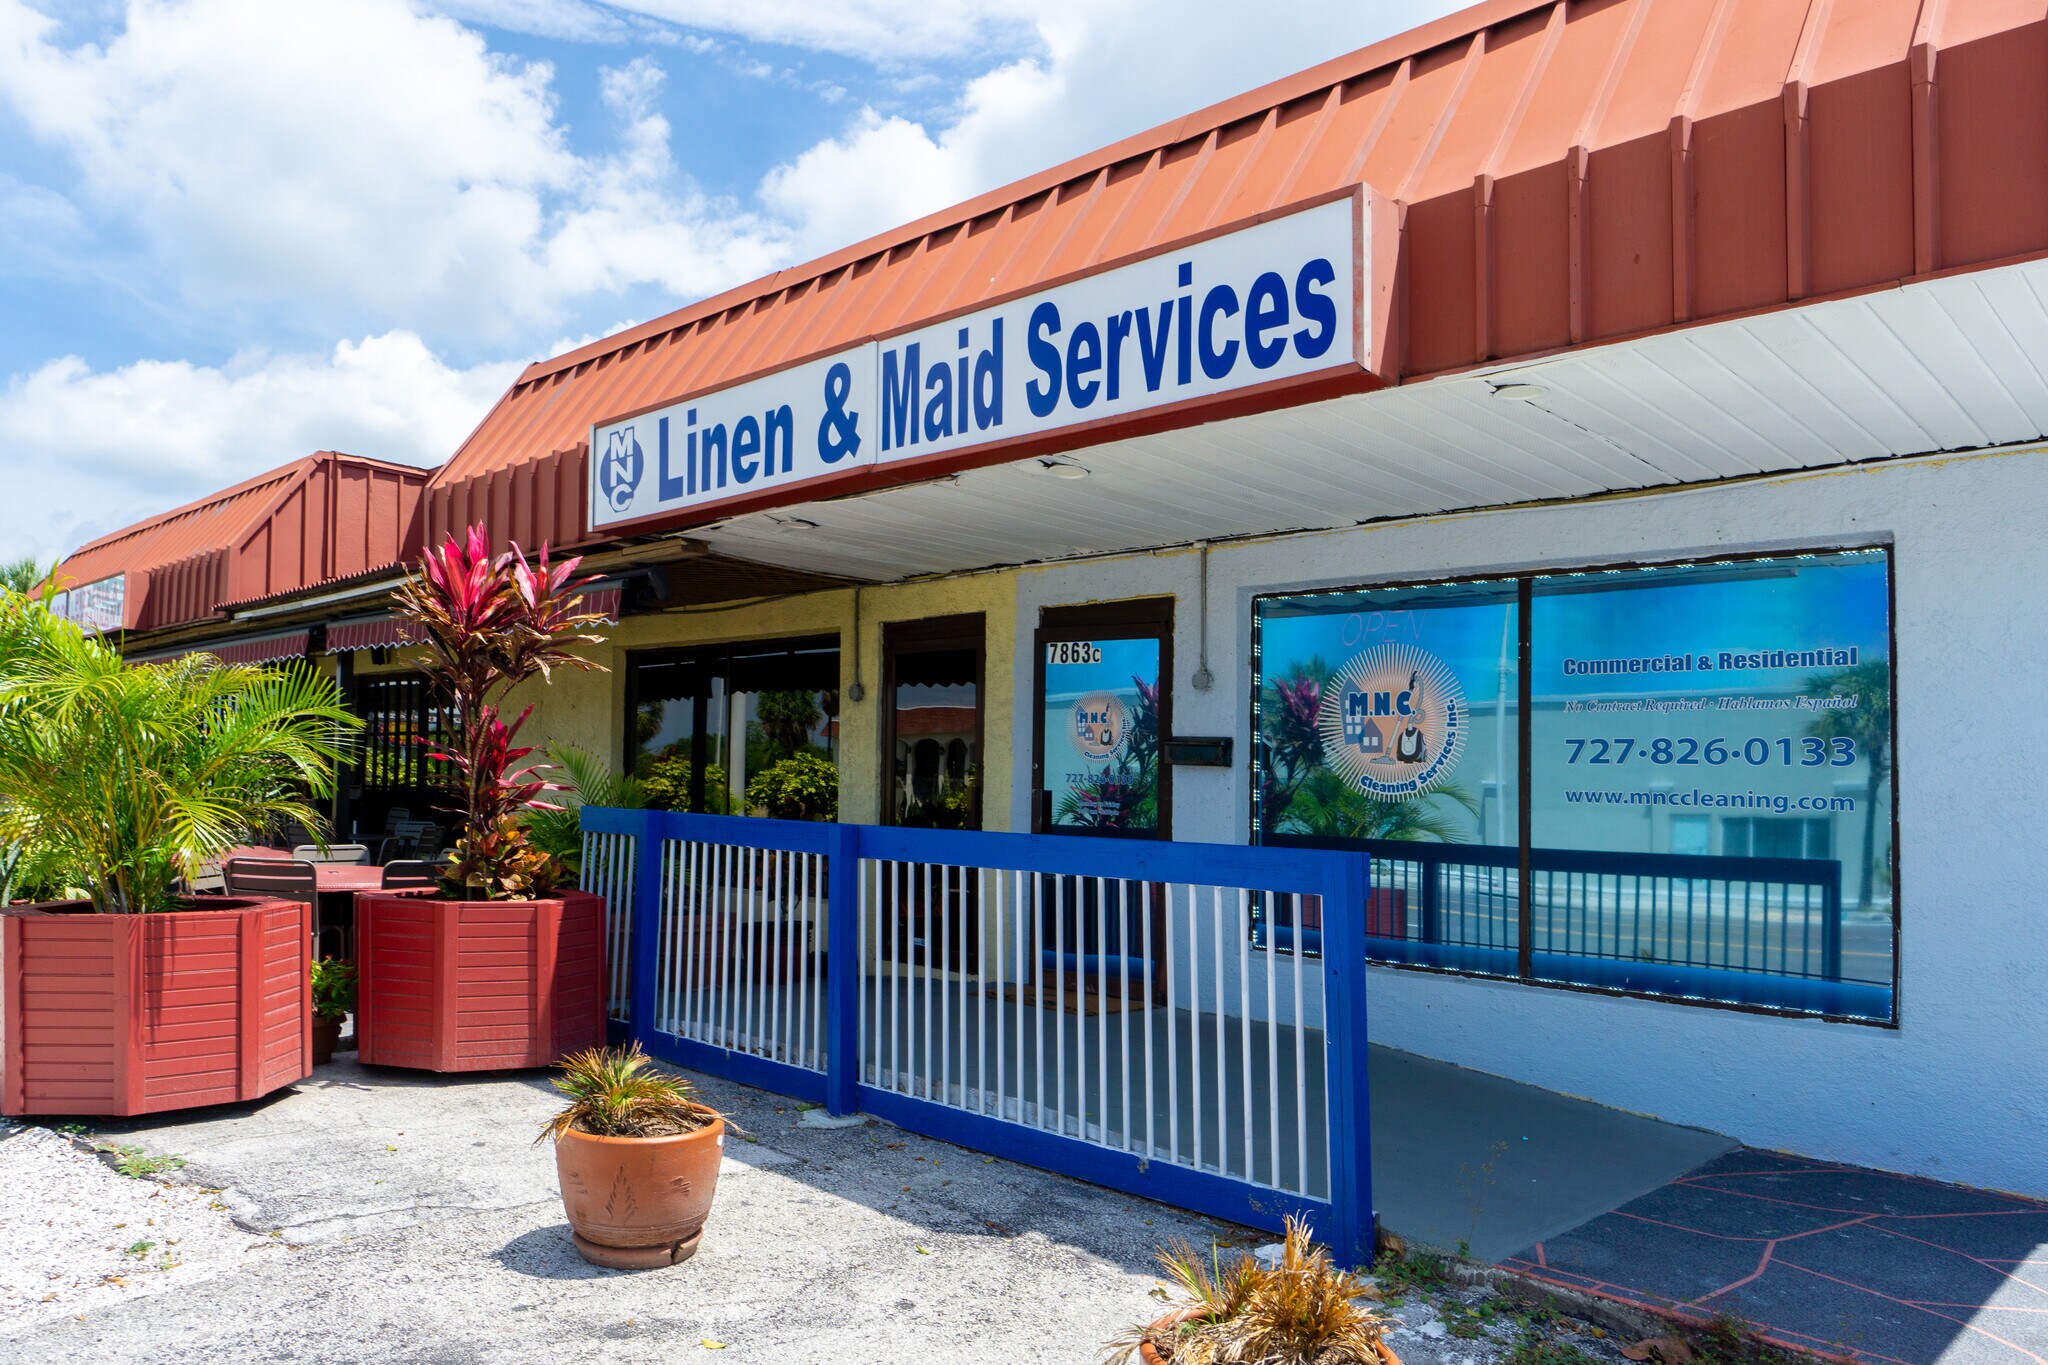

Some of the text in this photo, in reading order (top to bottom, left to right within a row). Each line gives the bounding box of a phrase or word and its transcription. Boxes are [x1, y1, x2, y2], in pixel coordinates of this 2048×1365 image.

[658, 258, 1337, 502] Linen & Maid Services
[1341, 609, 1427, 647] OPEN
[1563, 646, 1858, 676] Commercial & Residential
[1348, 690, 1417, 717] M.N.C.
[1564, 694, 1858, 714] No Contract Required Hablamos Español
[1360, 697, 1458, 793] Cleaning Services Inc.
[1565, 788, 1856, 813] www.mnccleaning.com
